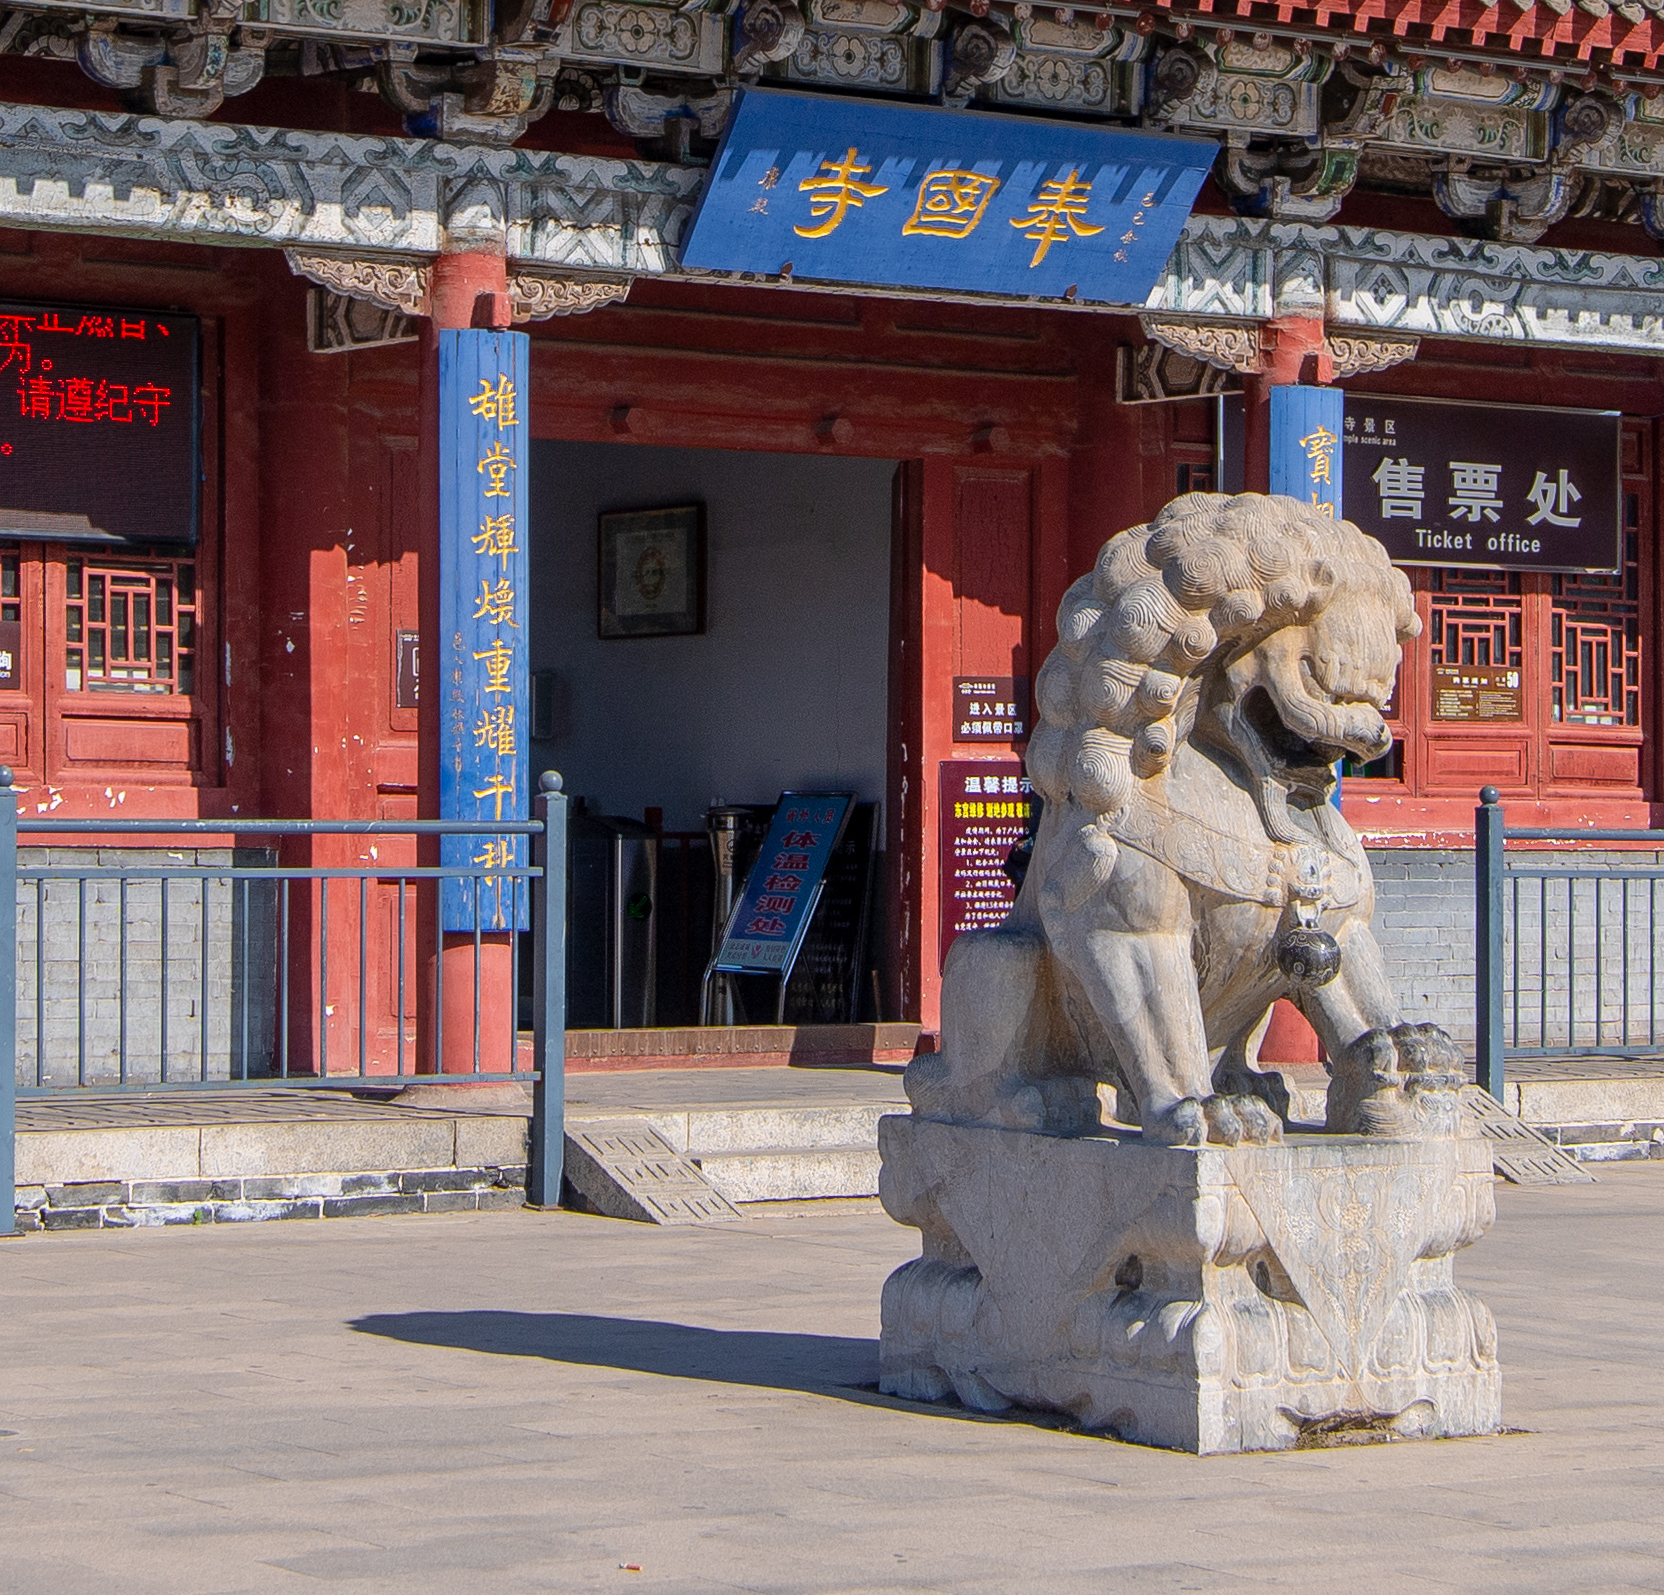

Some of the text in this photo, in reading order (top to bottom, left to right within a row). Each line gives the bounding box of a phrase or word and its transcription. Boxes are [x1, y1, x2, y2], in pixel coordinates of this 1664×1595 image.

[1371, 456, 1583, 529] 售票处
[1415, 528, 1542, 553] Ticket office
[1506, 670, 1519, 689] 50
[969, 702, 1017, 716] 进入景区
[964, 775, 1035, 794] 温馨提示
[744, 830, 822, 937] 体温检测处
